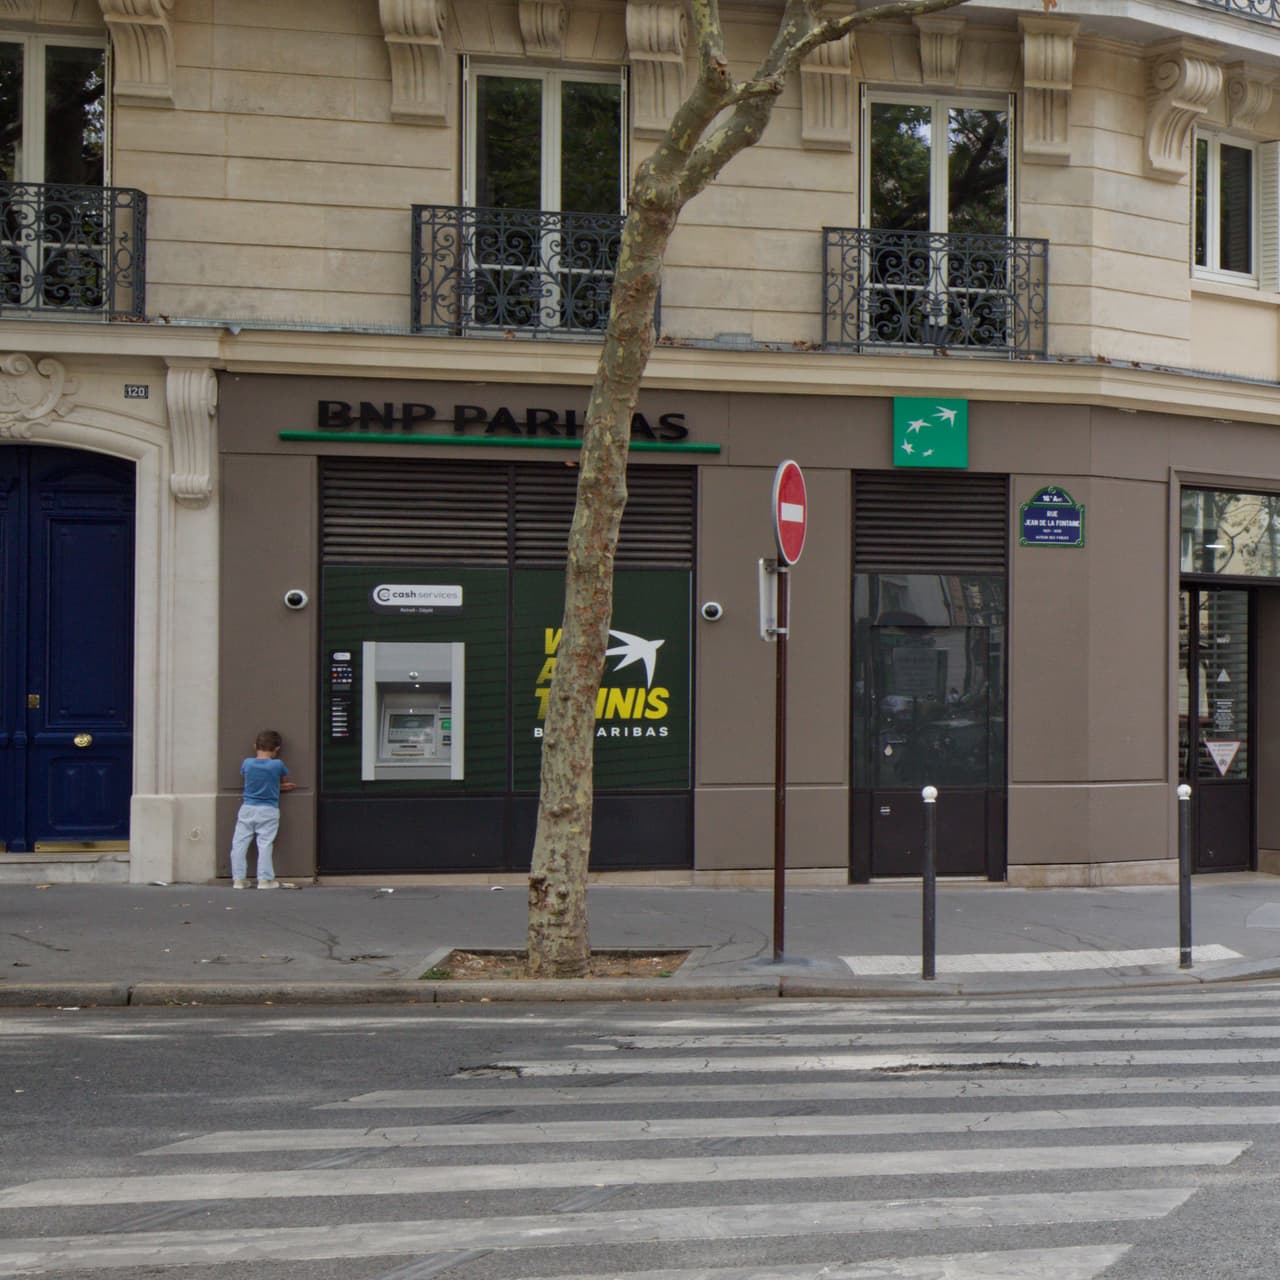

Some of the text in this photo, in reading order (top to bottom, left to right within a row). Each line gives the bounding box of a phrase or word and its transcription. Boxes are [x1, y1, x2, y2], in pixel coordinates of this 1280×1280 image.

[128, 387, 145, 396] 120
[318, 400, 689, 442] BNP PARIAS
[1056, 519, 1080, 527] FONTAINE
[392, 589, 457, 599] cash services
[597, 727, 669, 737] ARIBAS
